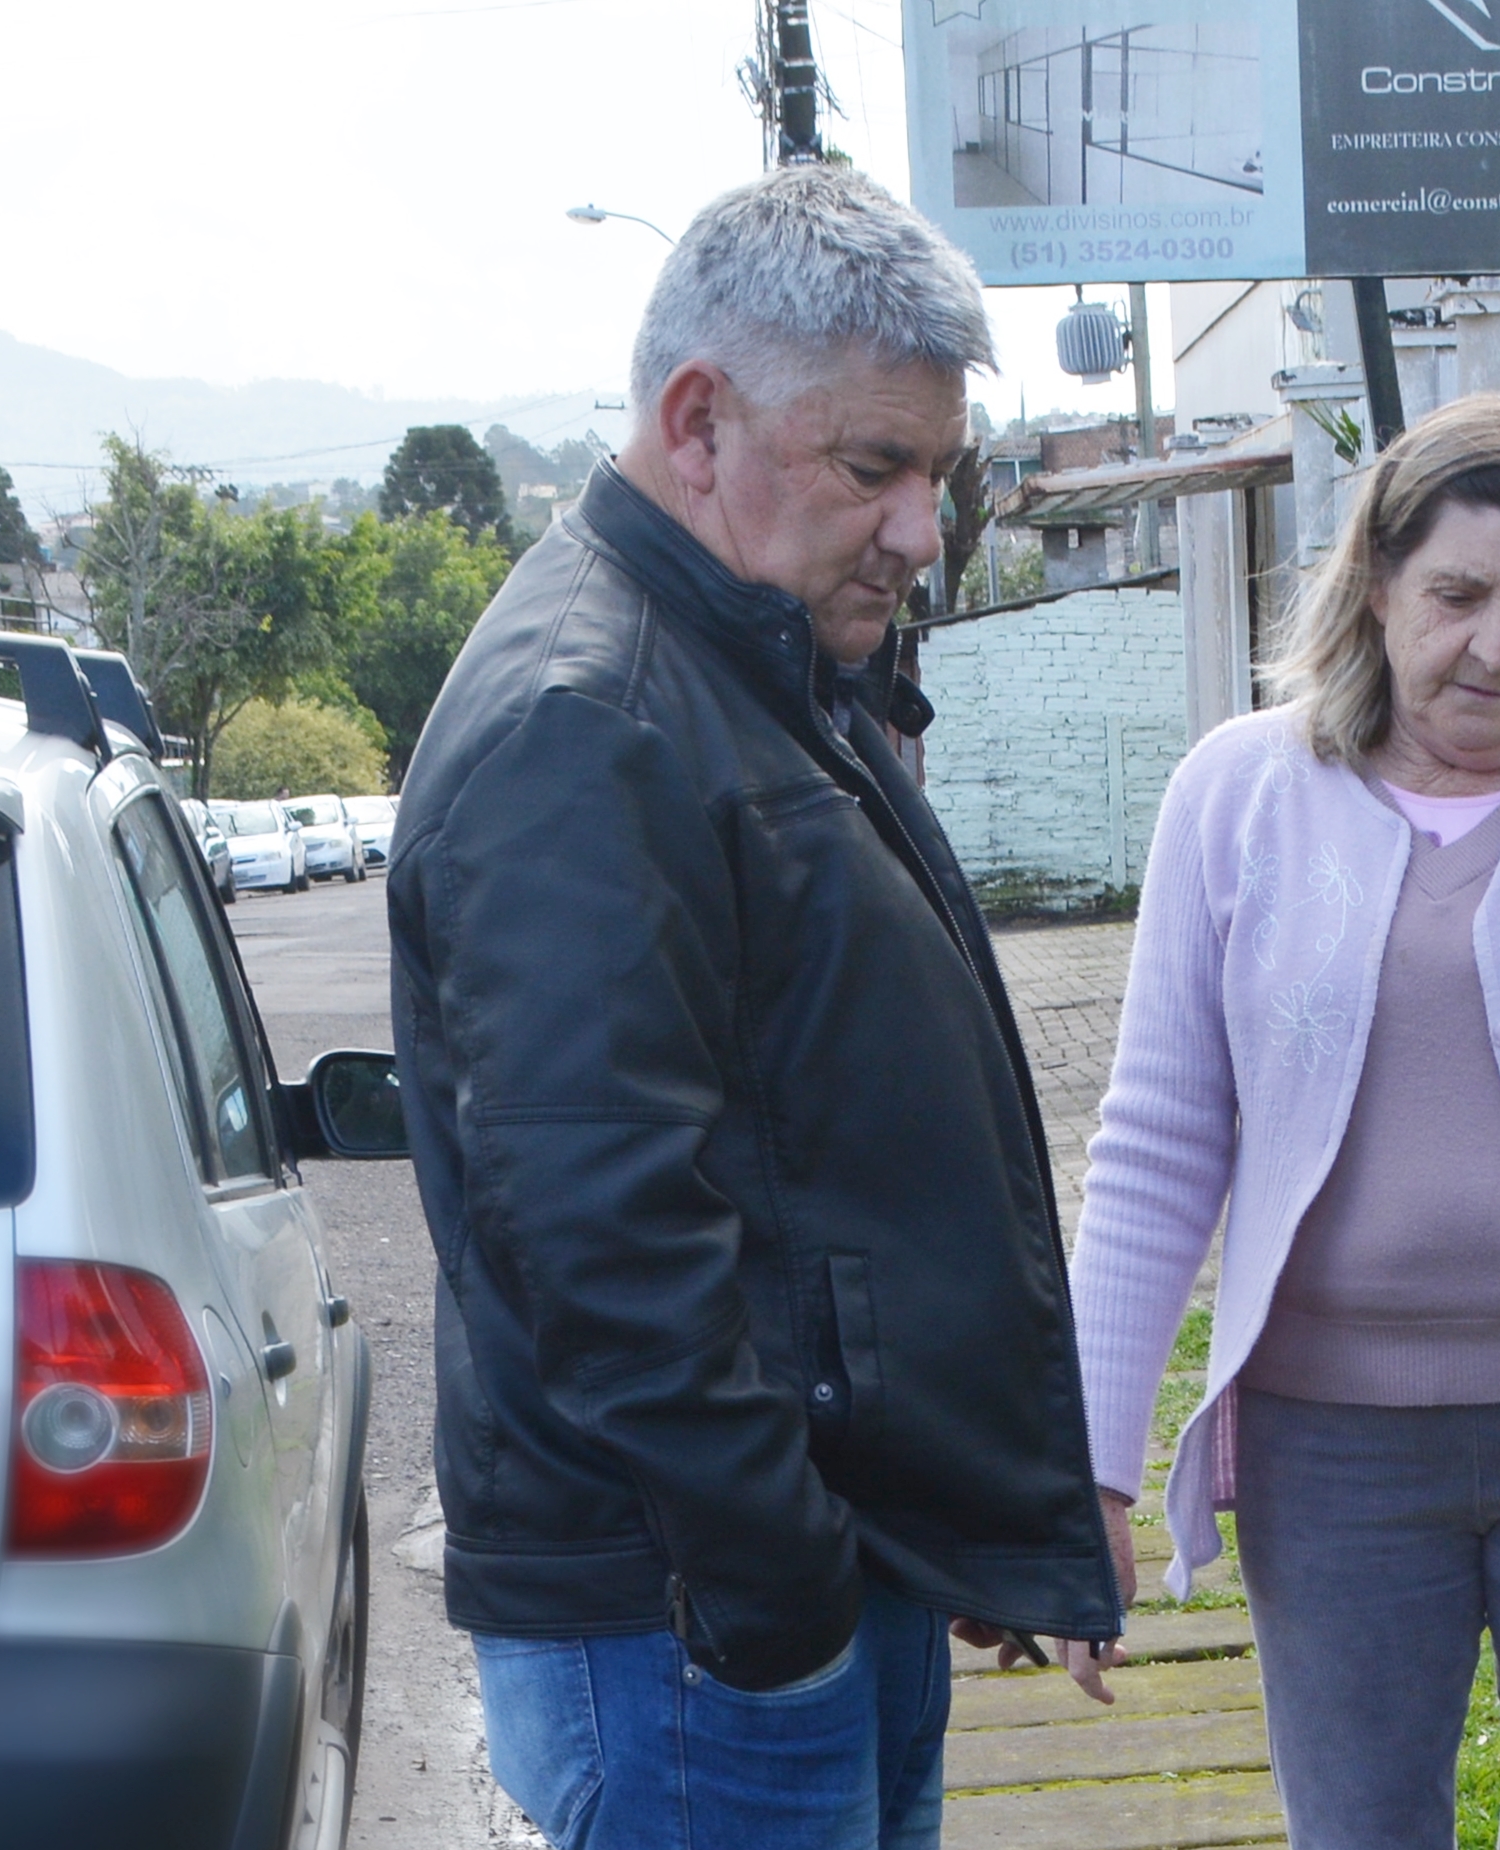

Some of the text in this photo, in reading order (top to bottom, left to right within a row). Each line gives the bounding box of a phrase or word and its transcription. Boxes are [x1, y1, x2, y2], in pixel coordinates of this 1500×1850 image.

[1331, 132, 1452, 151] EMPREITEIRA
[989, 205, 1255, 233] www.divisinos.com.br
[1010, 236, 1235, 269] (51) 3524-0300
